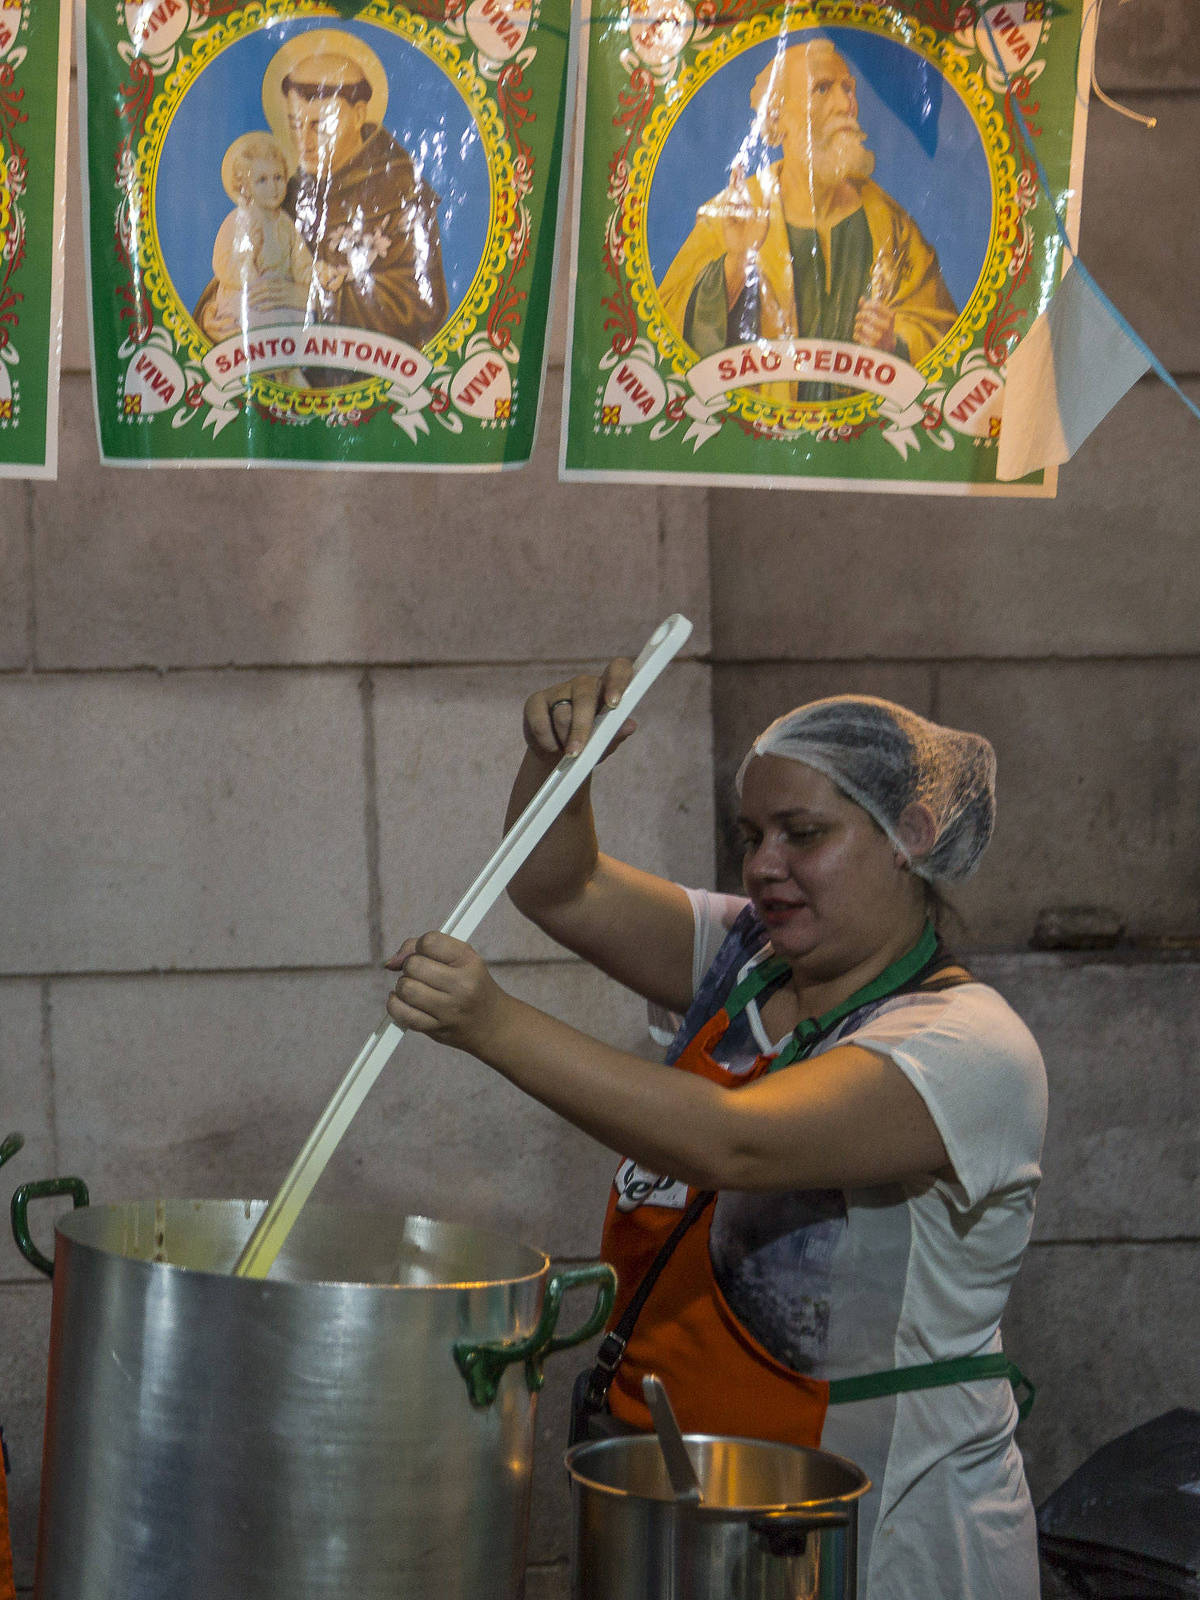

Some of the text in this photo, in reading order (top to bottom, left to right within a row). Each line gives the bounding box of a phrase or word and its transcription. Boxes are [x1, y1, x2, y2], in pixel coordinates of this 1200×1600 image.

[133, 0, 181, 40] IVA
[991, 6, 1031, 63] VIVA
[135, 353, 175, 404] VIVA
[215, 337, 418, 377] SANTO ANTONIO
[717, 349, 897, 385] SÃO PEDRO
[456, 360, 503, 406] VIVA
[616, 364, 656, 416] VIVA
[949, 376, 999, 424] VIVA
